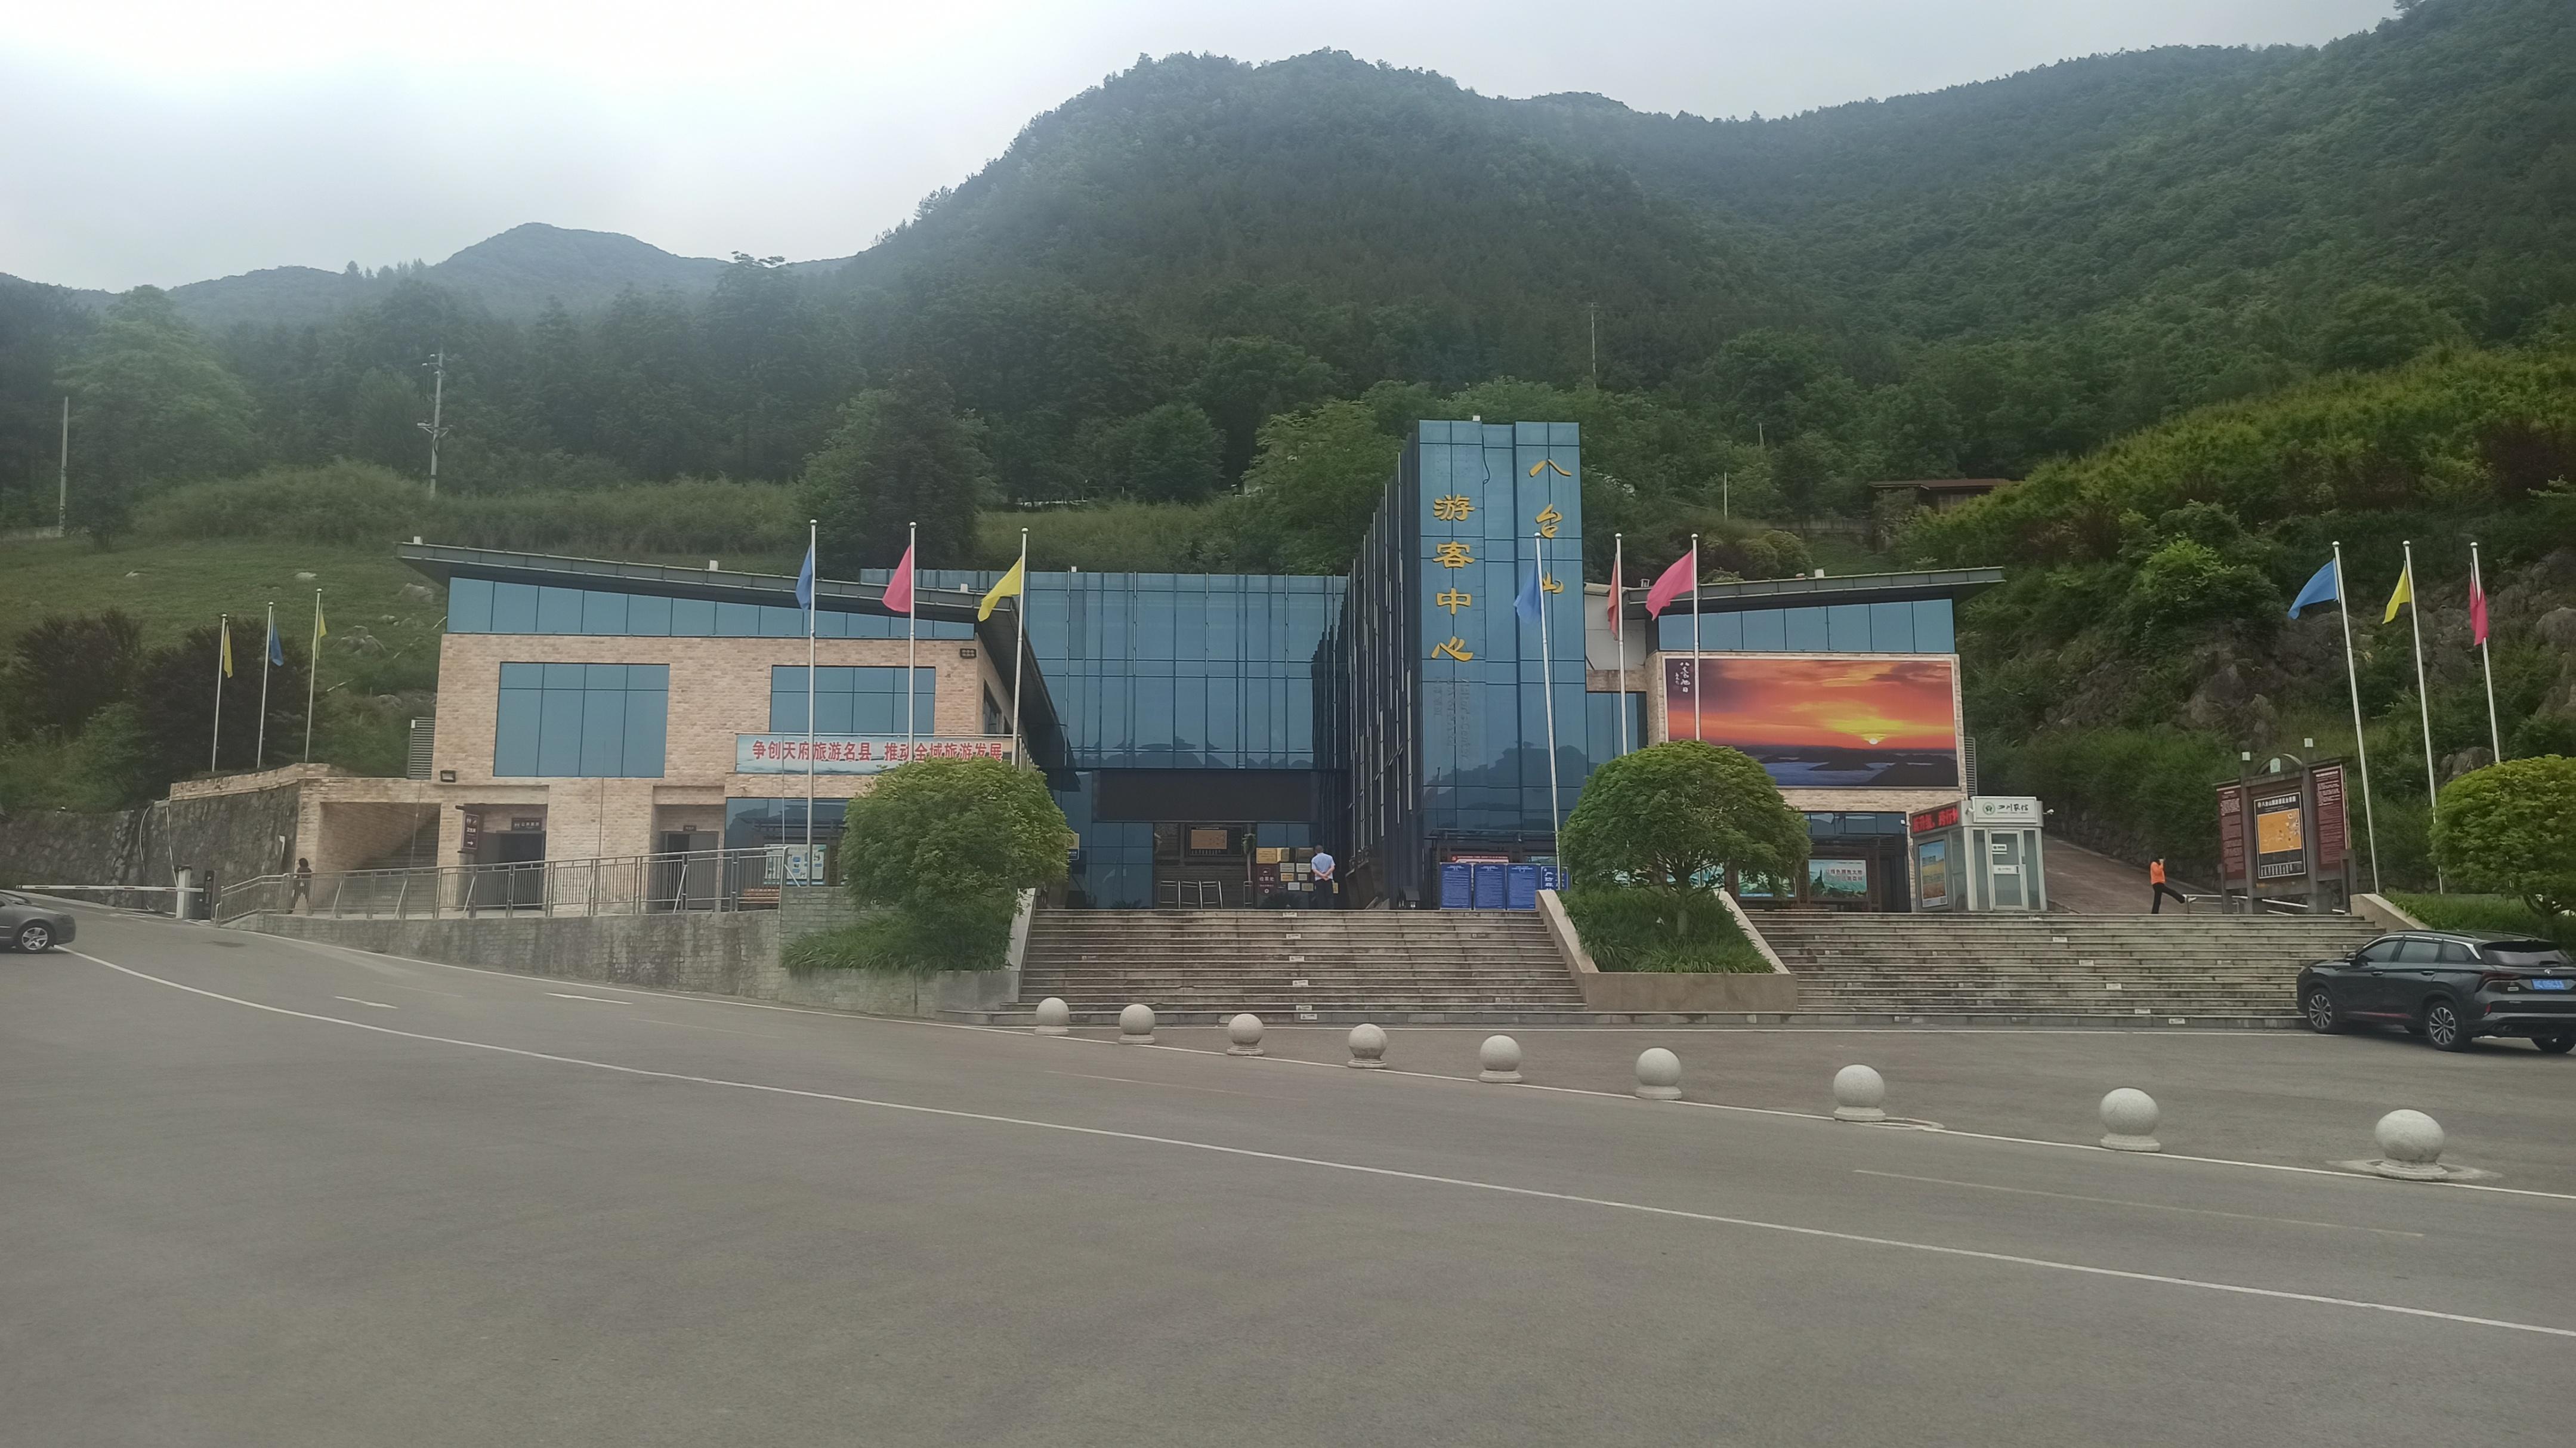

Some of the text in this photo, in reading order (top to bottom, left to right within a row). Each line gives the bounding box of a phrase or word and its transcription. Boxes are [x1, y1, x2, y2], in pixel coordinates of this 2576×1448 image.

[1431, 493, 1475, 662] 游客中心
[1529, 458, 1572, 594] 八台山
[752, 740, 1003, 763] 争创天府旅游名县 推动全域旅游发展
